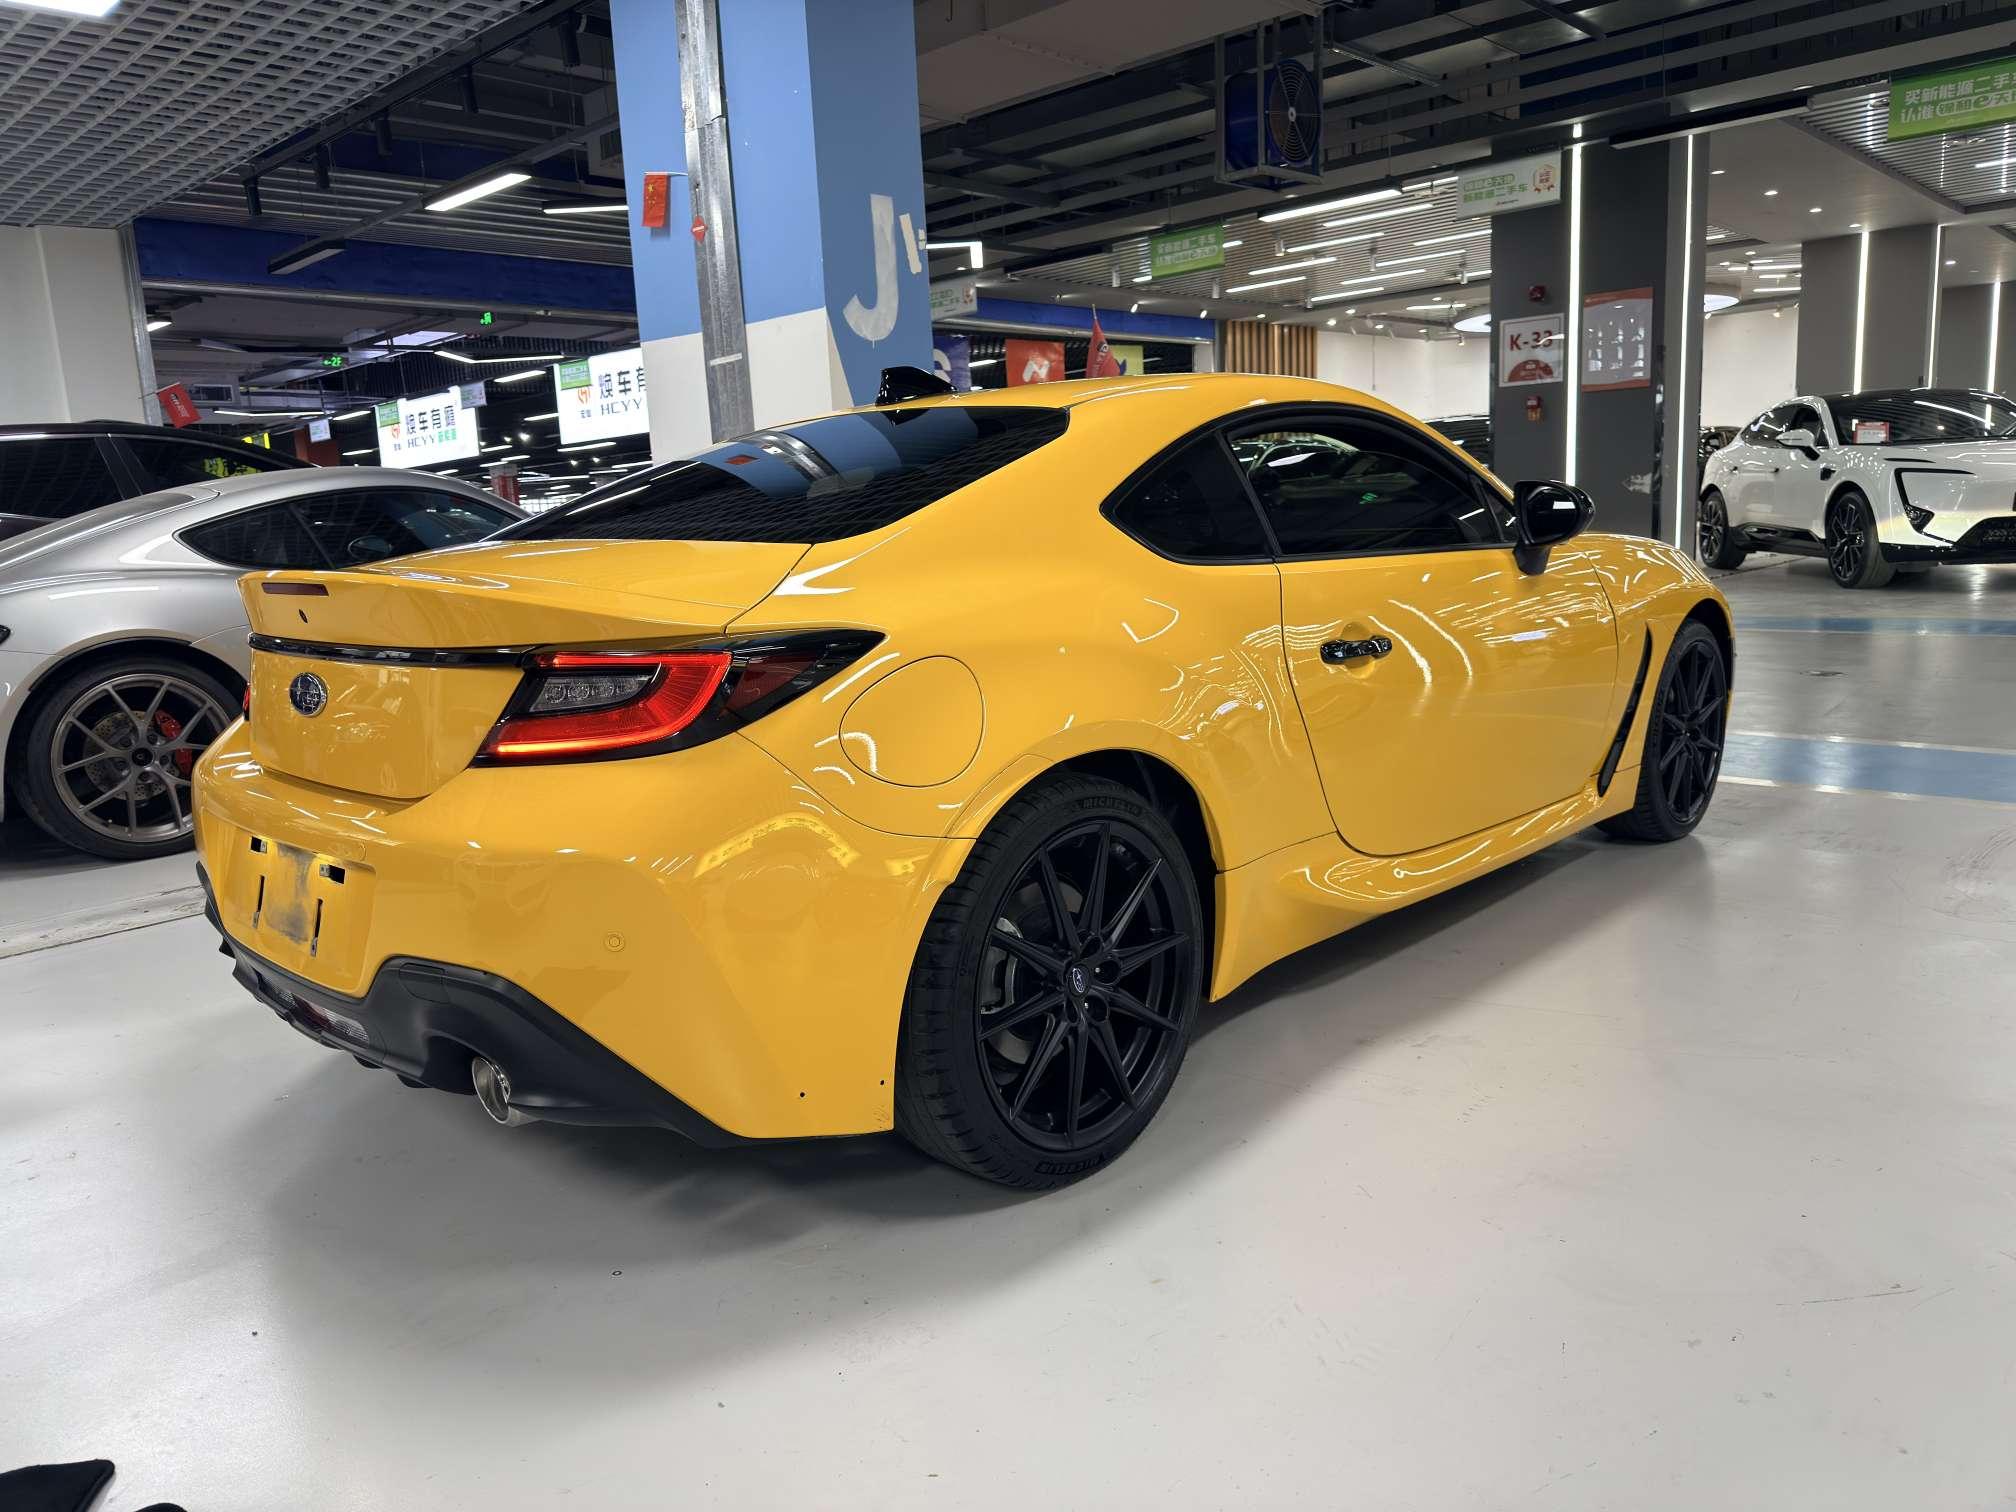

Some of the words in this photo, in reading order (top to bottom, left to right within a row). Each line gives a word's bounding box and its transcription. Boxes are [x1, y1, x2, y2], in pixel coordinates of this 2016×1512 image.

[1904, 72, 2016, 105] 买新能源二手
[1510, 330, 1553, 351] K-33
